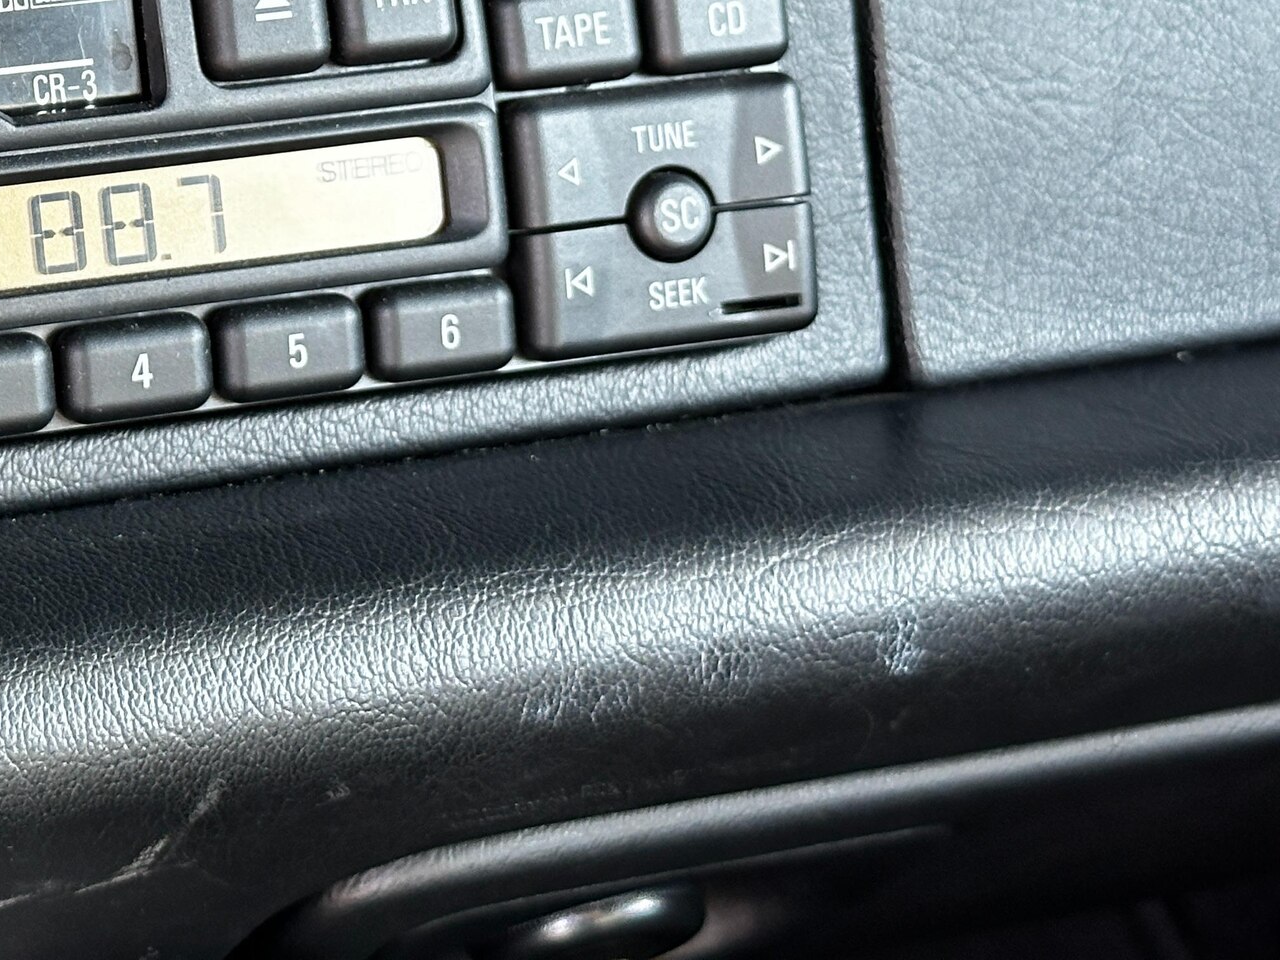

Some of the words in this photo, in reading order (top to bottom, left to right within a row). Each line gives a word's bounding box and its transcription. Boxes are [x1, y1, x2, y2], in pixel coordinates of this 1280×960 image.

[534, 10, 611, 50] TAPE
[707, 0, 747, 37] CD
[32, 69, 98, 106] CR-3
[631, 119, 697, 154] TUNE
[316, 150, 421, 184] STEREO
[29, 173, 227, 275] 88.7
[659, 195, 702, 233] SC
[648, 277, 709, 312] SEEK
[440, 313, 462, 350] 6
[287, 332, 309, 369] 5
[130, 352, 154, 389] 4
